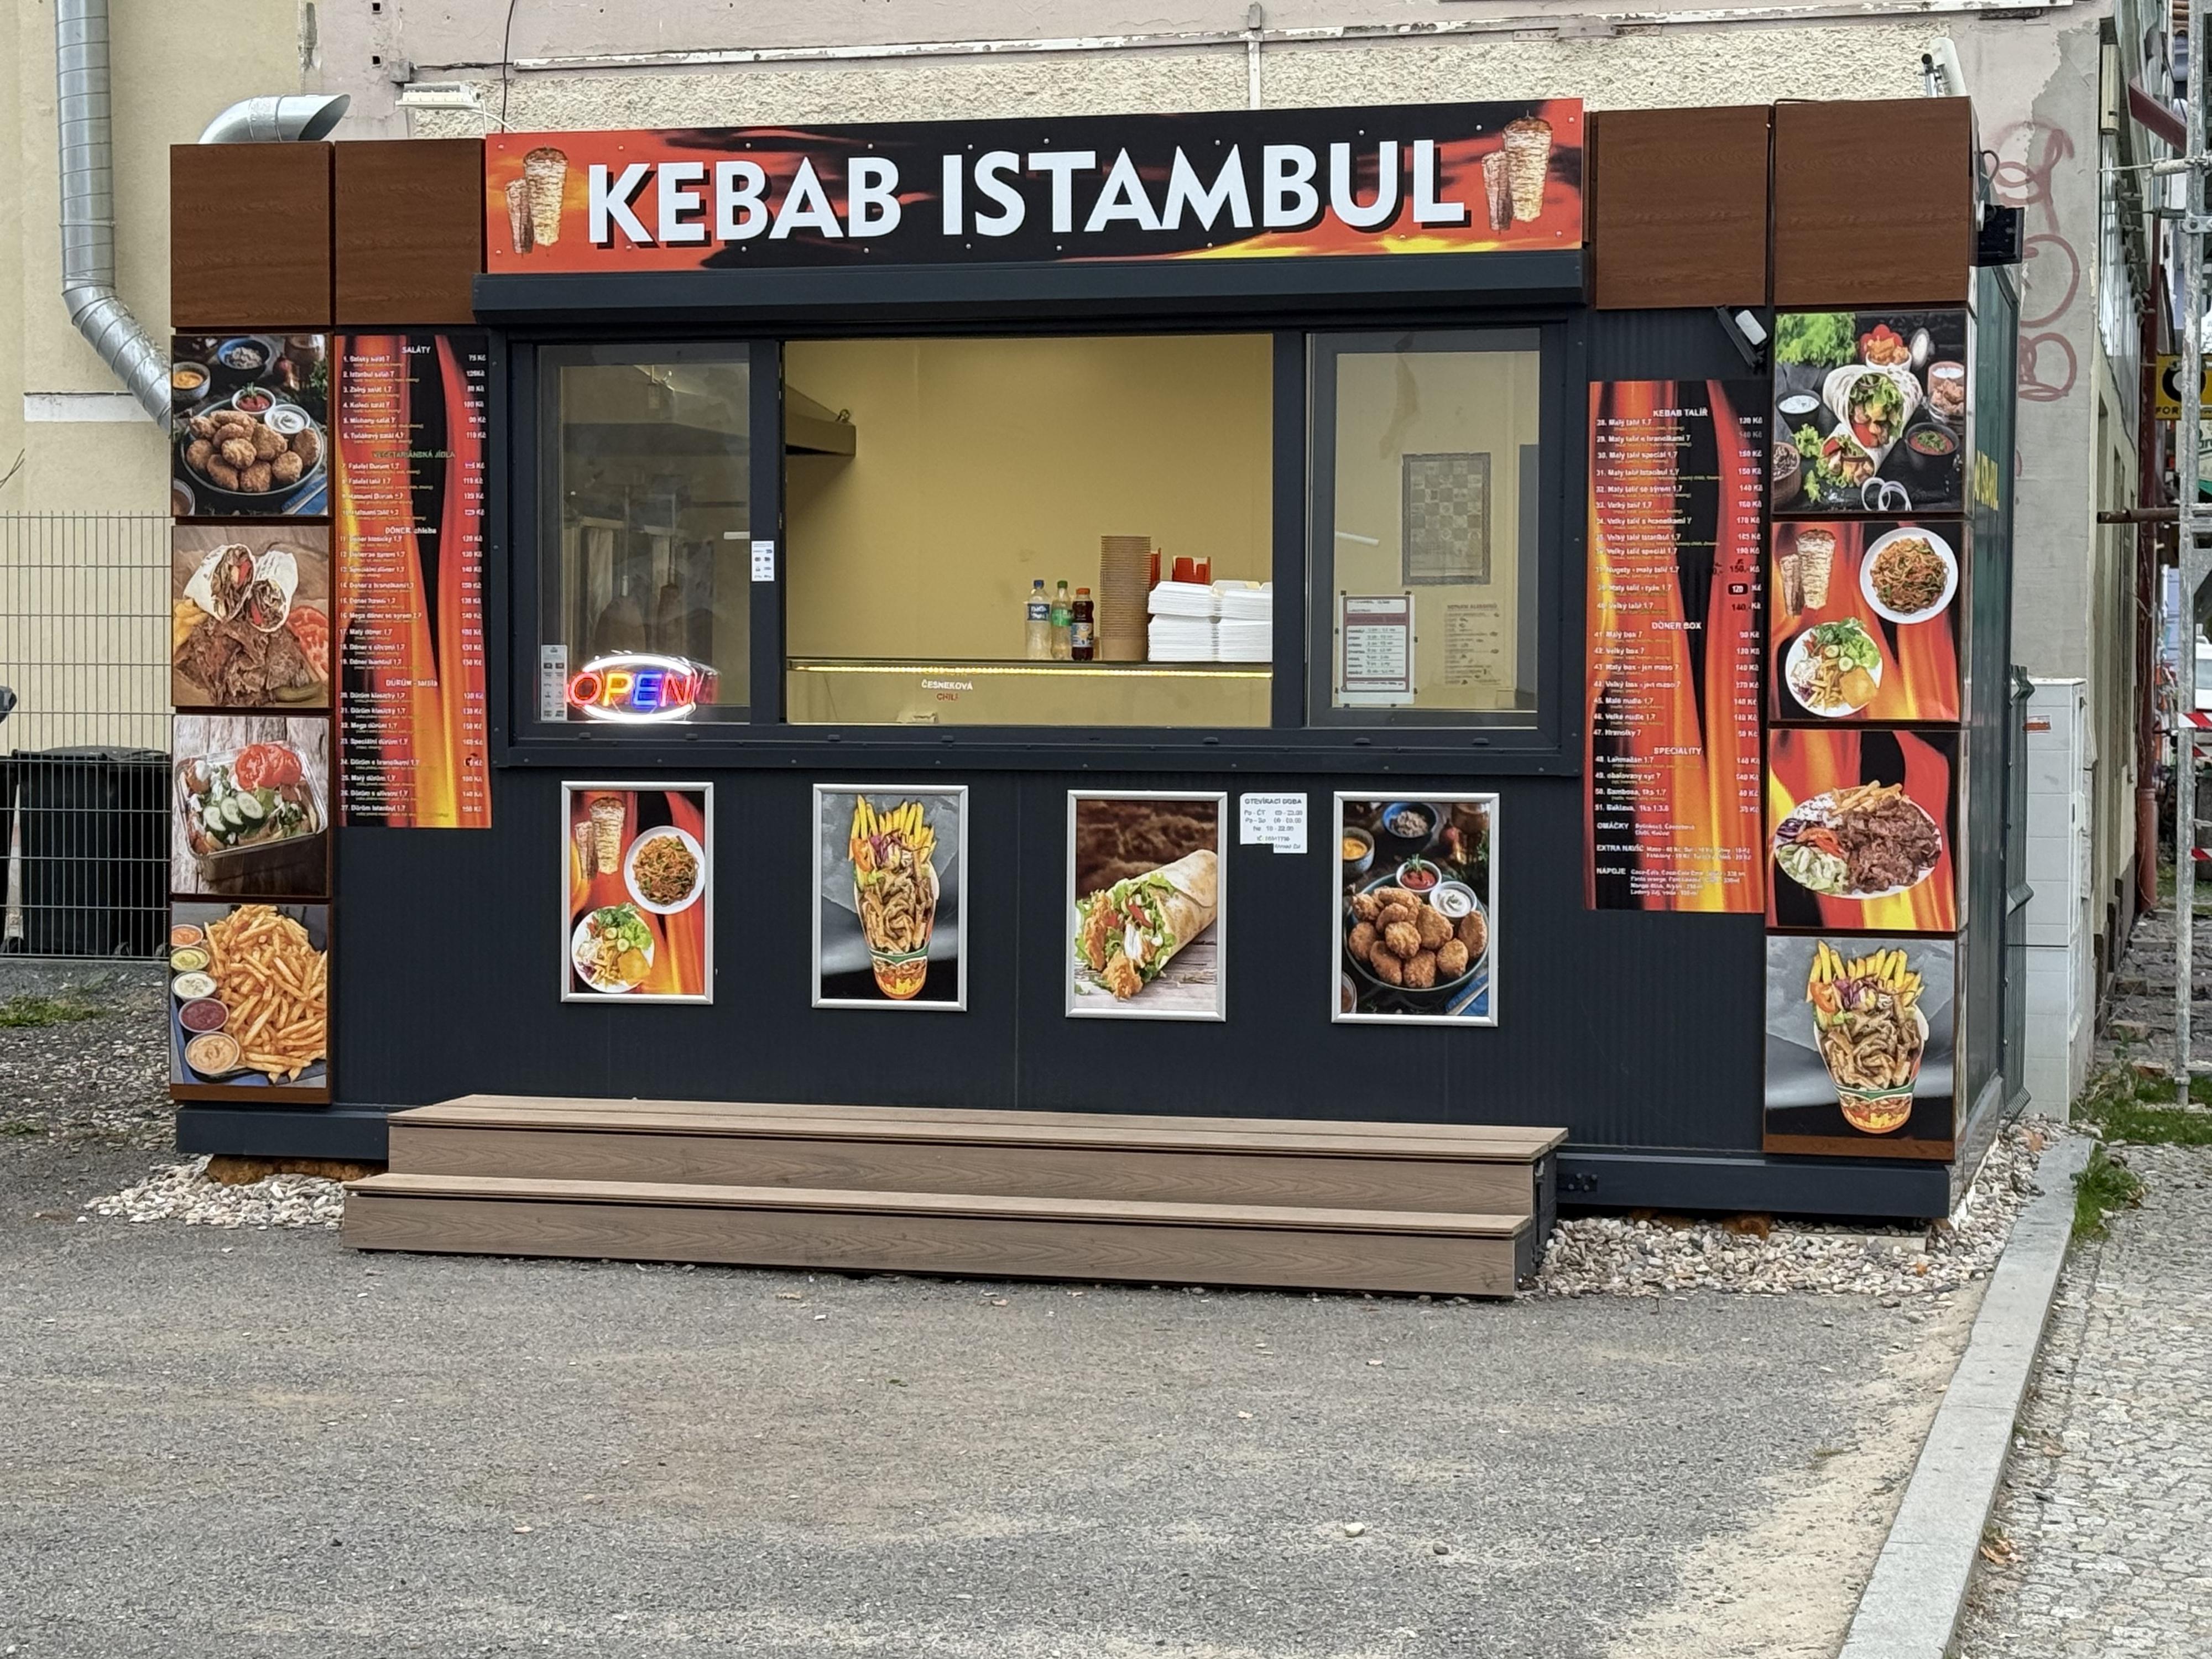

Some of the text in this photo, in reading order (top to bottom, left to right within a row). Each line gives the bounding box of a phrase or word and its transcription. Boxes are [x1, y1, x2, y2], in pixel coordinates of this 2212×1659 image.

[587, 138, 1466, 243] KEBAB ISTAMBUL
[1684, 407, 1708, 416] TALÍŘ
[1651, 620, 1682, 630] DÖNER
[569, 671, 691, 707] OPEN
[921, 679, 973, 690] ČESNEKOVÁ
[1597, 821, 1629, 830] OMÁČKY
[1597, 865, 1626, 874] NÁPOJE
